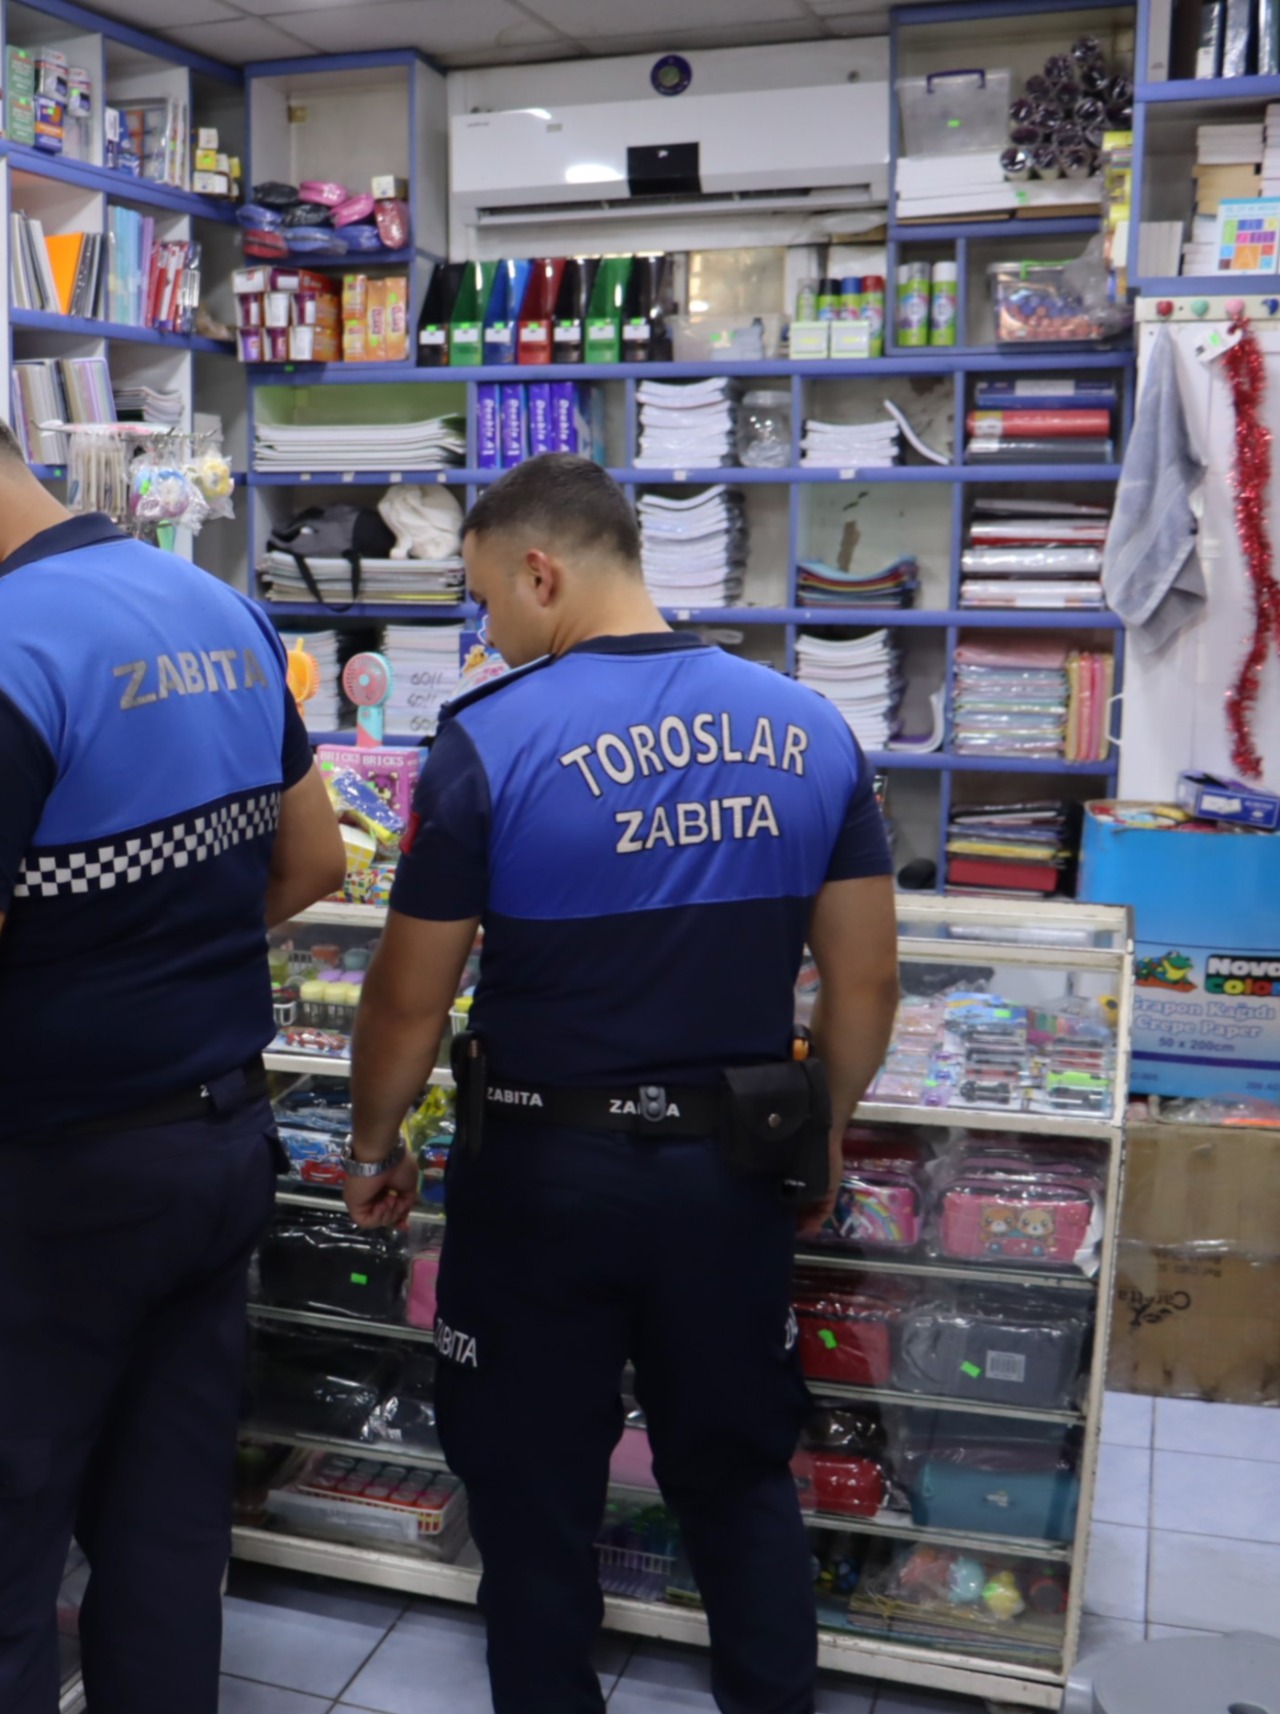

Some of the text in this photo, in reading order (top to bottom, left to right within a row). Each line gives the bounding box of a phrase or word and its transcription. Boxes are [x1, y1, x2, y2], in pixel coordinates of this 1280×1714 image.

[113, 648, 269, 711] ZABITA
[362, 753, 405, 767] BRICKS
[559, 712, 809, 798] TOROSLAR
[615, 794, 780, 854] ZABITA
[1135, 1014, 1262, 1039] Crepe Paper
[487, 1086, 544, 1107] ZABITA
[609, 1099, 680, 1117] ZAA
